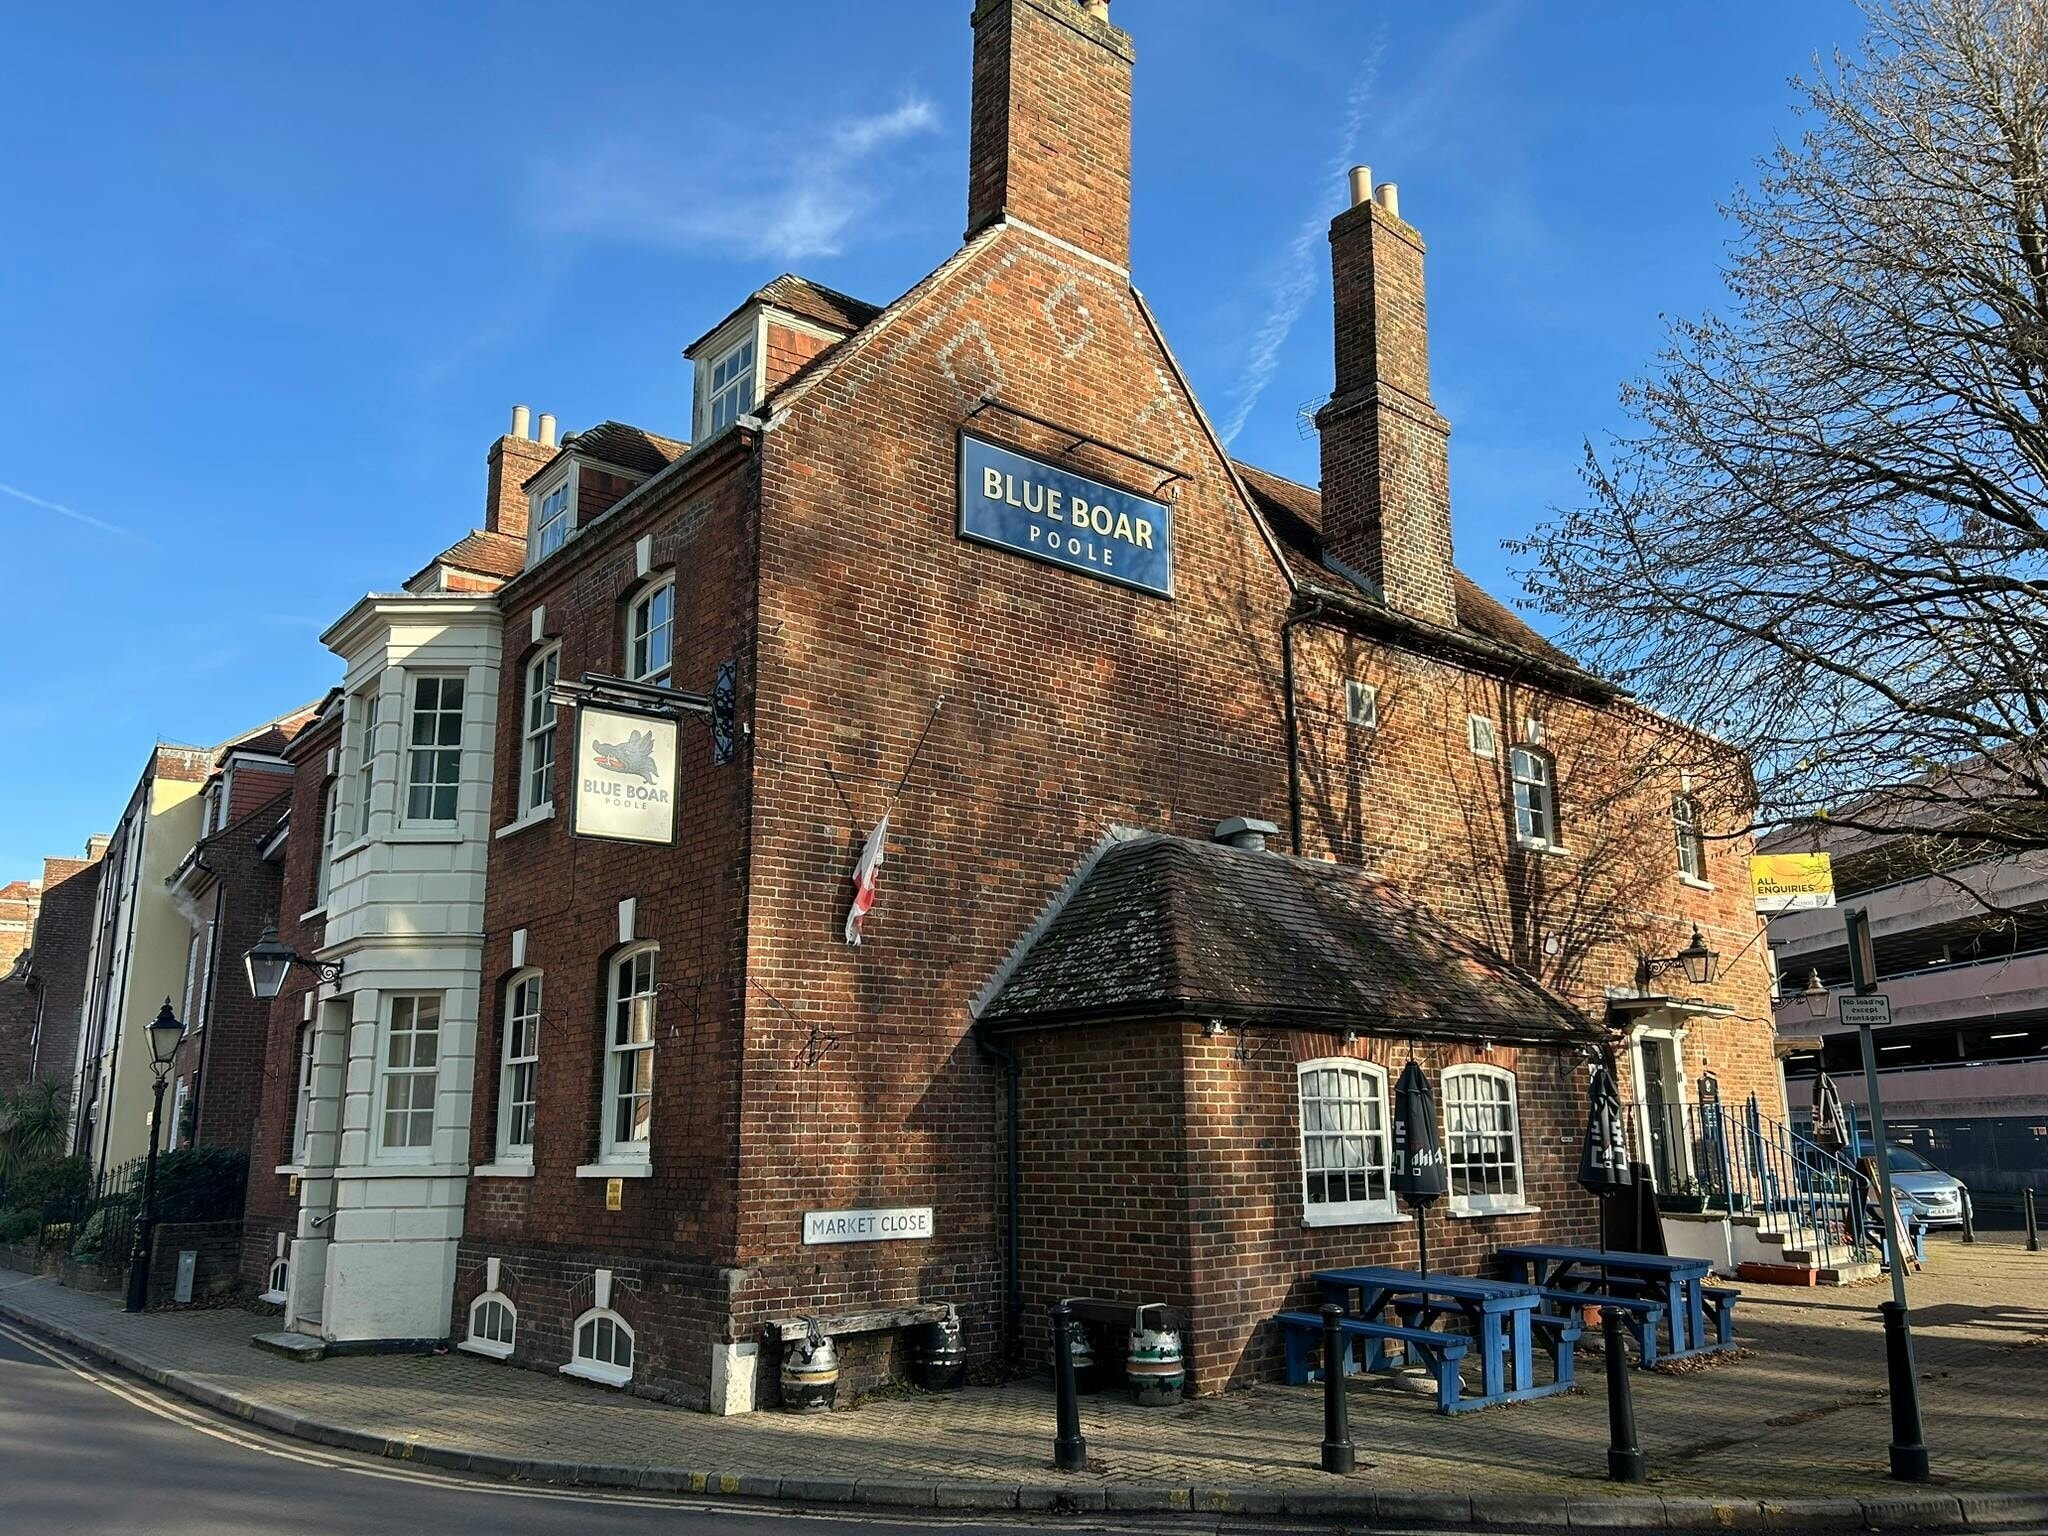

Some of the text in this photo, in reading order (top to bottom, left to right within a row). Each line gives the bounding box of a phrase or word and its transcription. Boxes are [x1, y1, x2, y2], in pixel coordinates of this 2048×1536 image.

[983, 466, 1153, 550] BLUE BOAR
[1030, 525, 1113, 566] POOLE
[583, 779, 668, 803] BLUE BOAR
[605, 797, 647, 810] POOLE
[1757, 877, 1777, 885] ALL
[1757, 884, 1815, 894] ENQUIRIES
[812, 1215, 926, 1235] MARKET CLOSE
